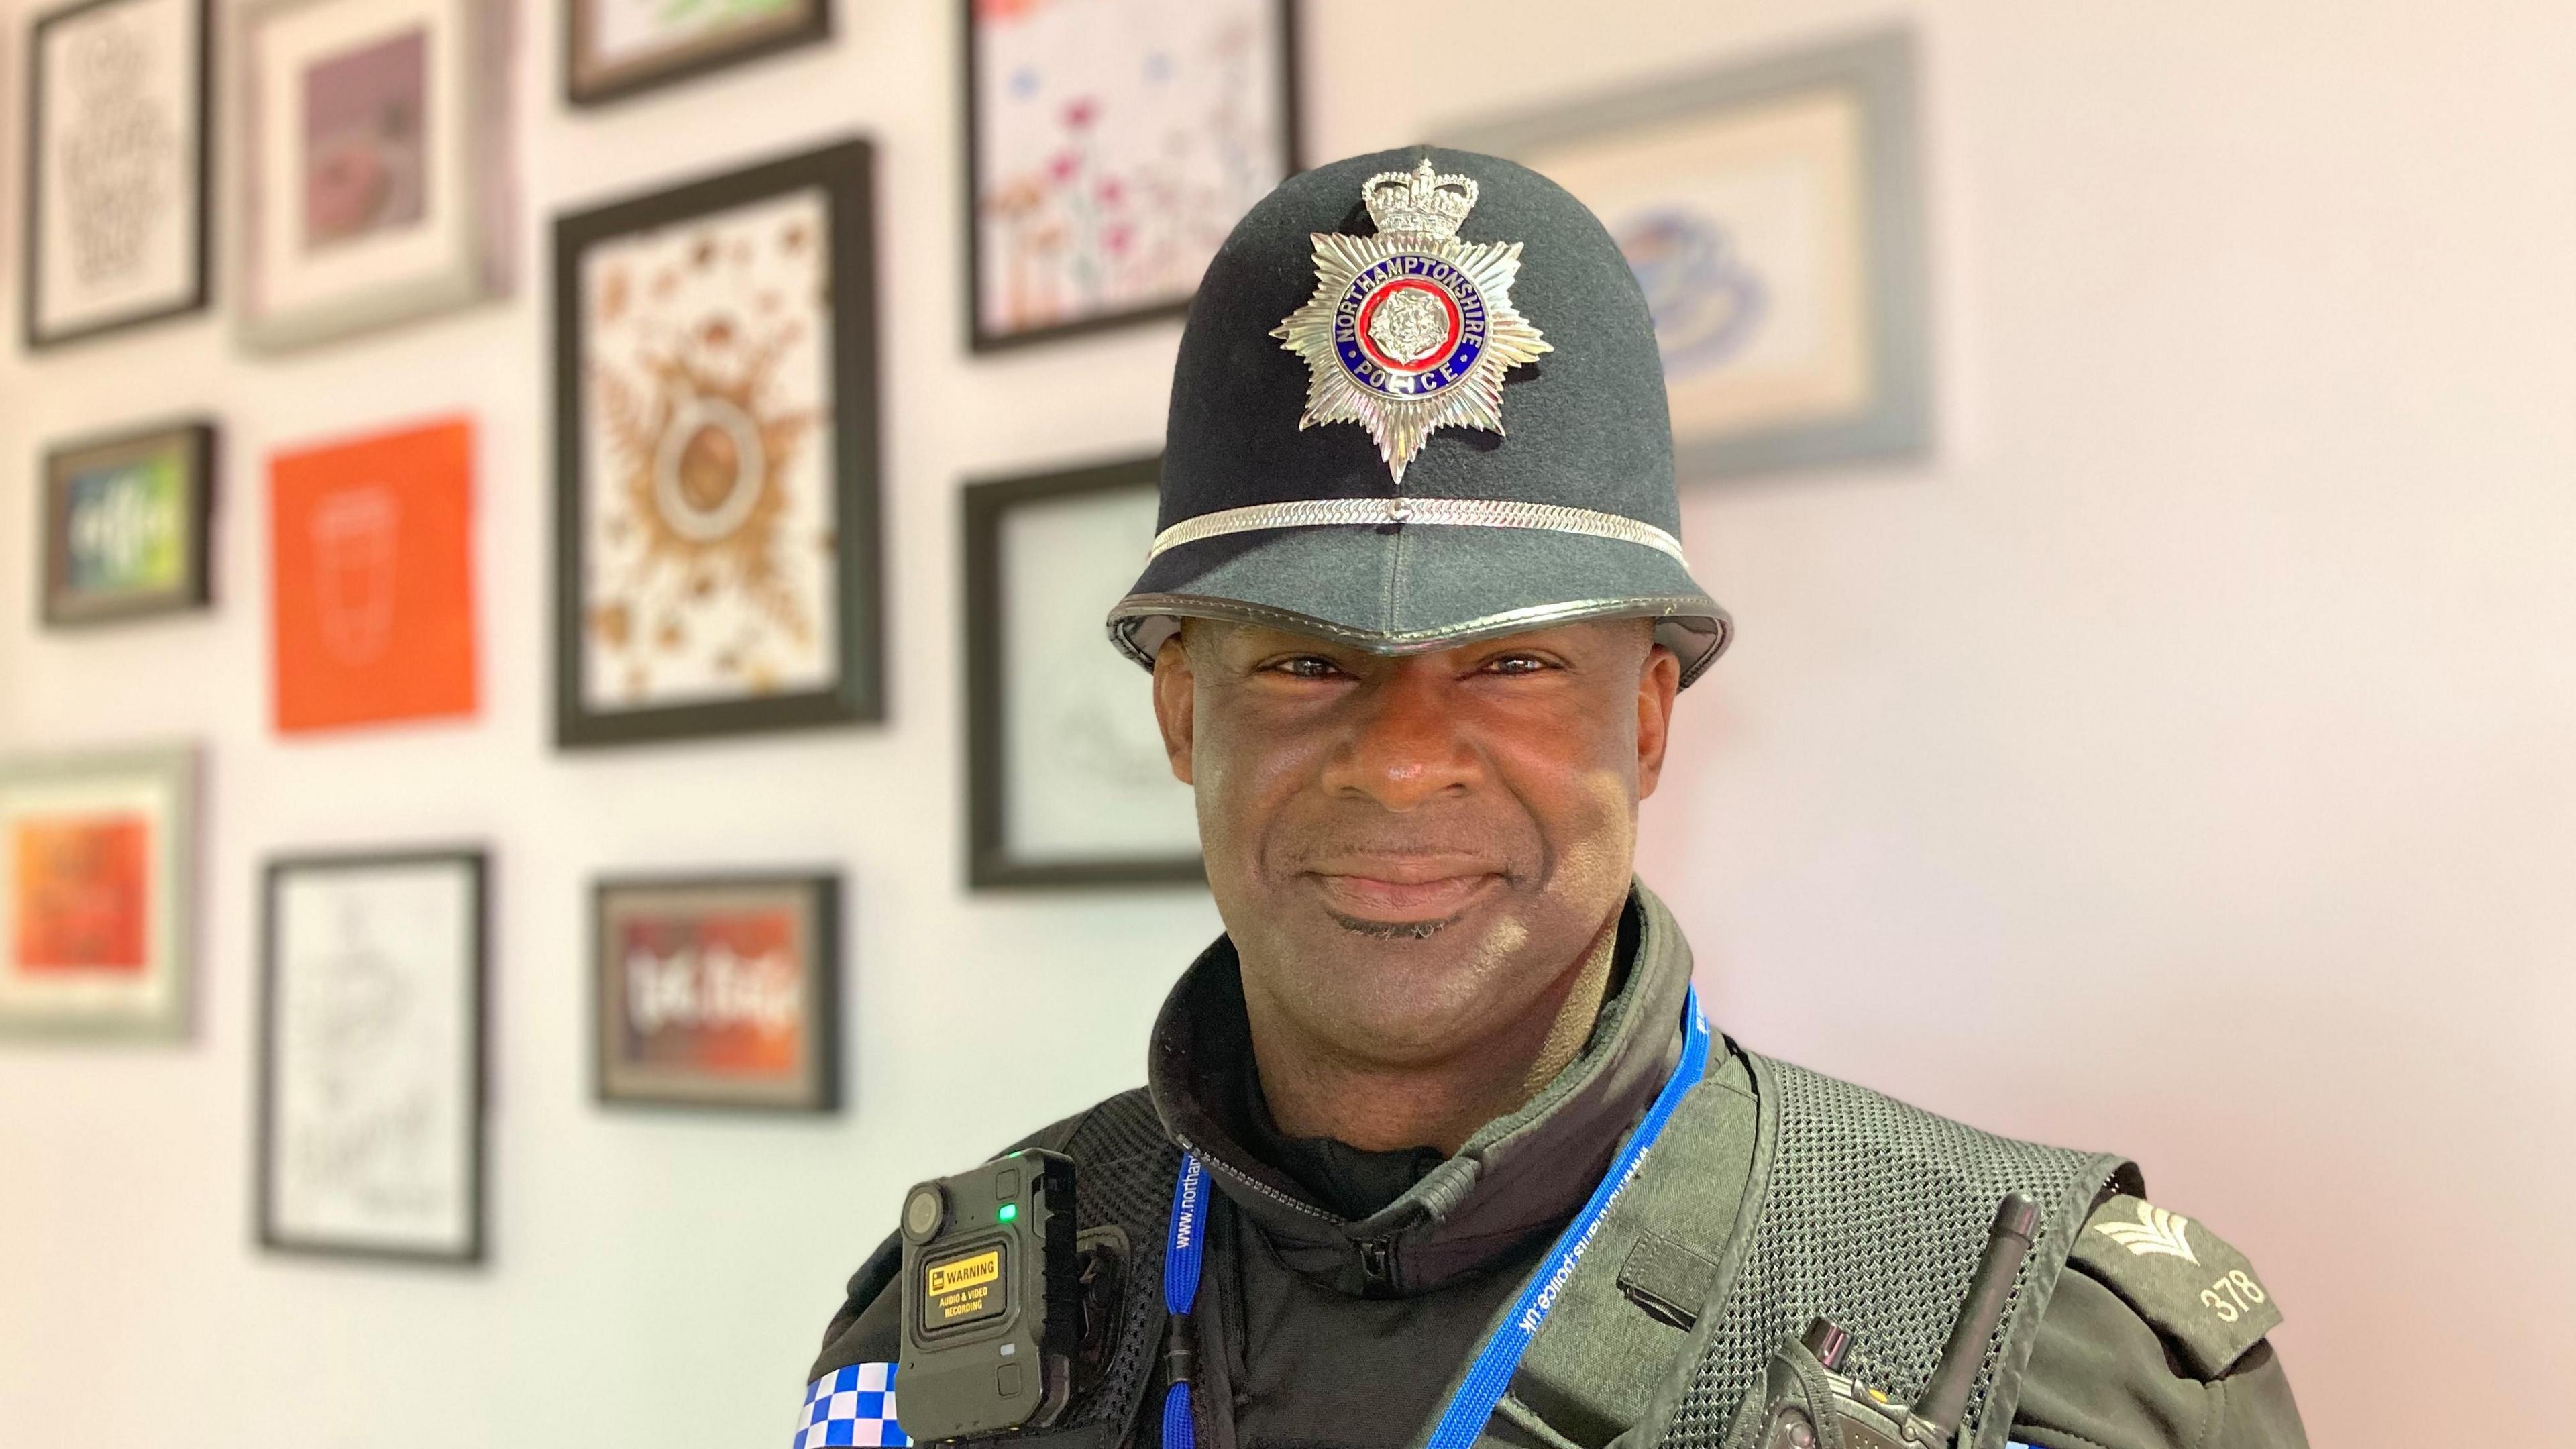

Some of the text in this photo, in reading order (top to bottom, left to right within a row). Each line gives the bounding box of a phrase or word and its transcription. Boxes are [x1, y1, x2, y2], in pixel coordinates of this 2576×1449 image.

[1336, 256, 1485, 349] NORTHAMPTONSHIRE
[1354, 362, 1459, 394] POLICE
[947, 1260, 994, 1285] WARNING
[939, 1286, 988, 1308] AUDIO & VIDEO
[945, 1299, 983, 1318] RECORDING
[2200, 1269, 2265, 1322] 378
